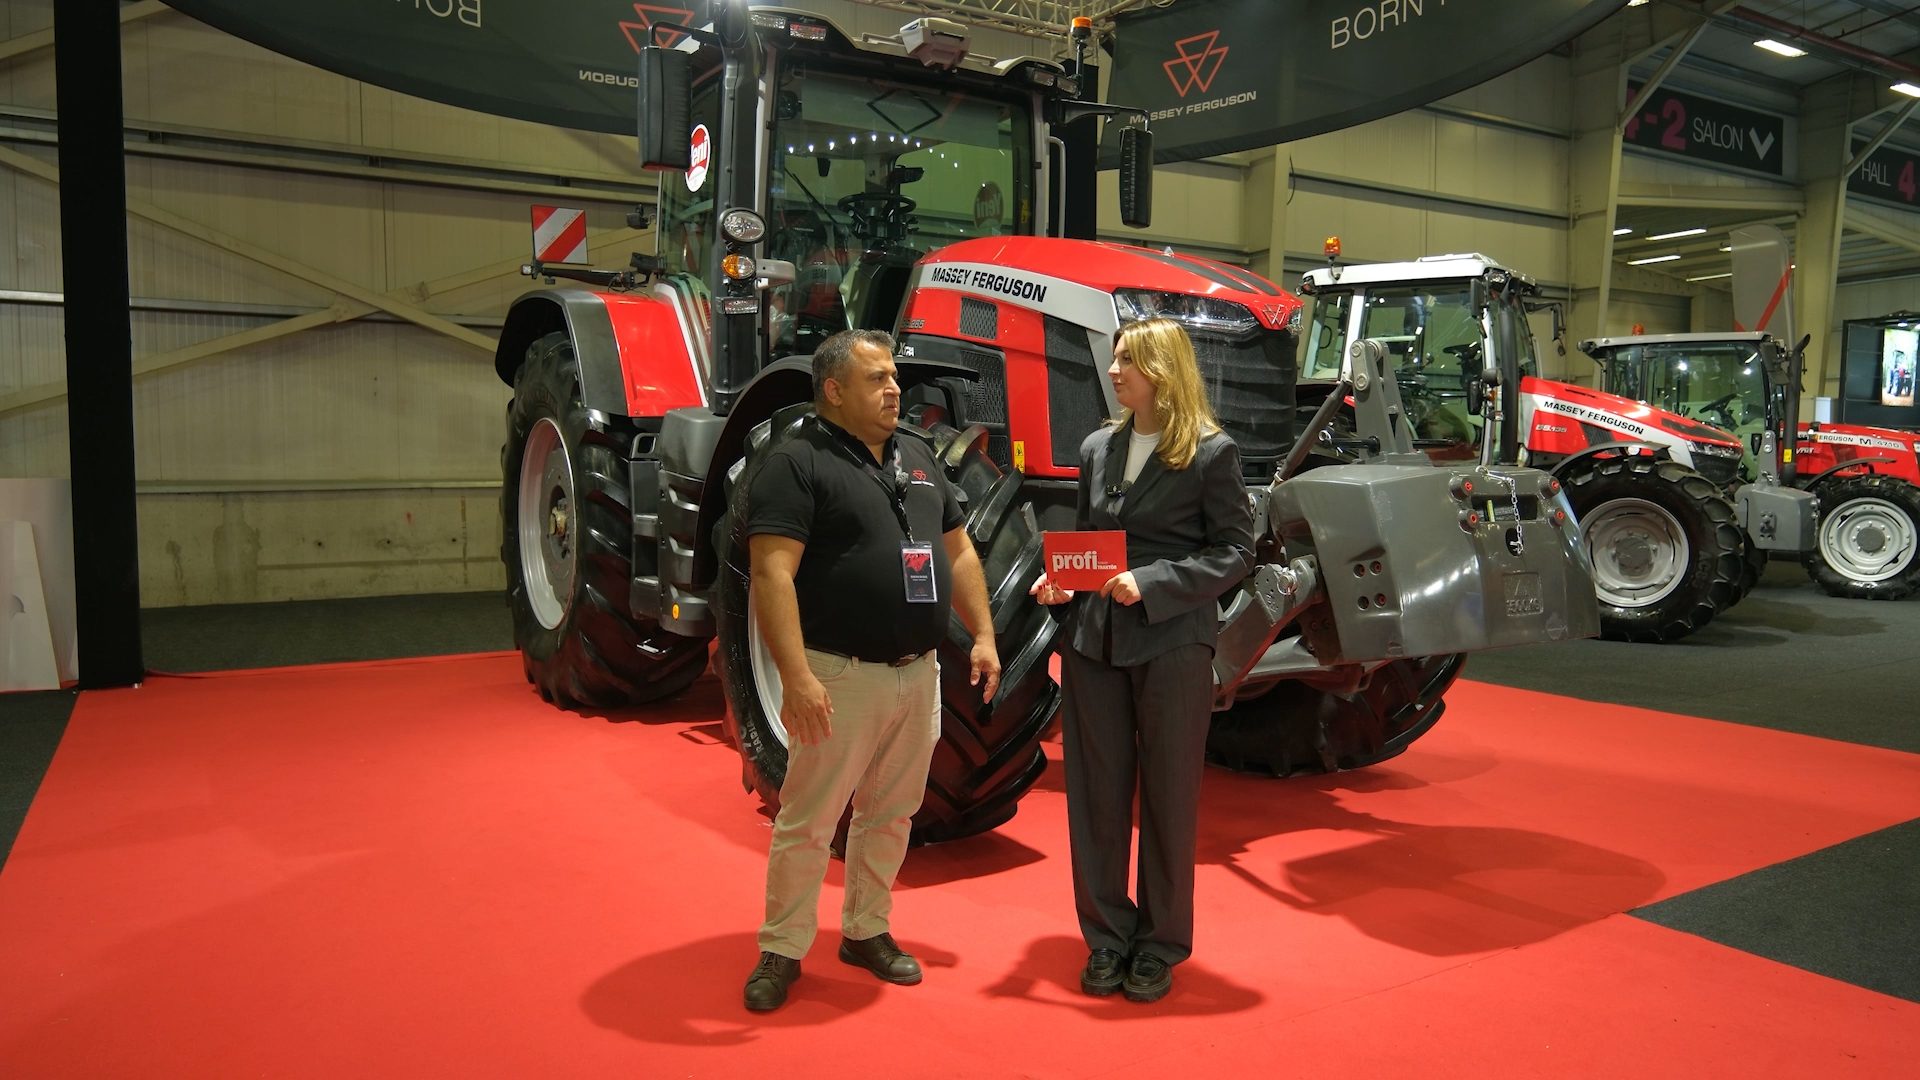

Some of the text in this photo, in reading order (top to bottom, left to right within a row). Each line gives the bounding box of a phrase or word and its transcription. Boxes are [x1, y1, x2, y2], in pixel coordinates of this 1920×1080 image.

[1331, 0, 1423, 49] BORN
[1186, 91, 1257, 115] FERGUSON
[1692, 116, 1744, 151] SALON
[1861, 160, 1891, 187] HALL
[931, 267, 1048, 303] MASSEY FERGUSON
[1544, 401, 1645, 435] MASSEY FERGUSON
[1859, 438, 1872, 446] M
[1052, 550, 1098, 573] profi
